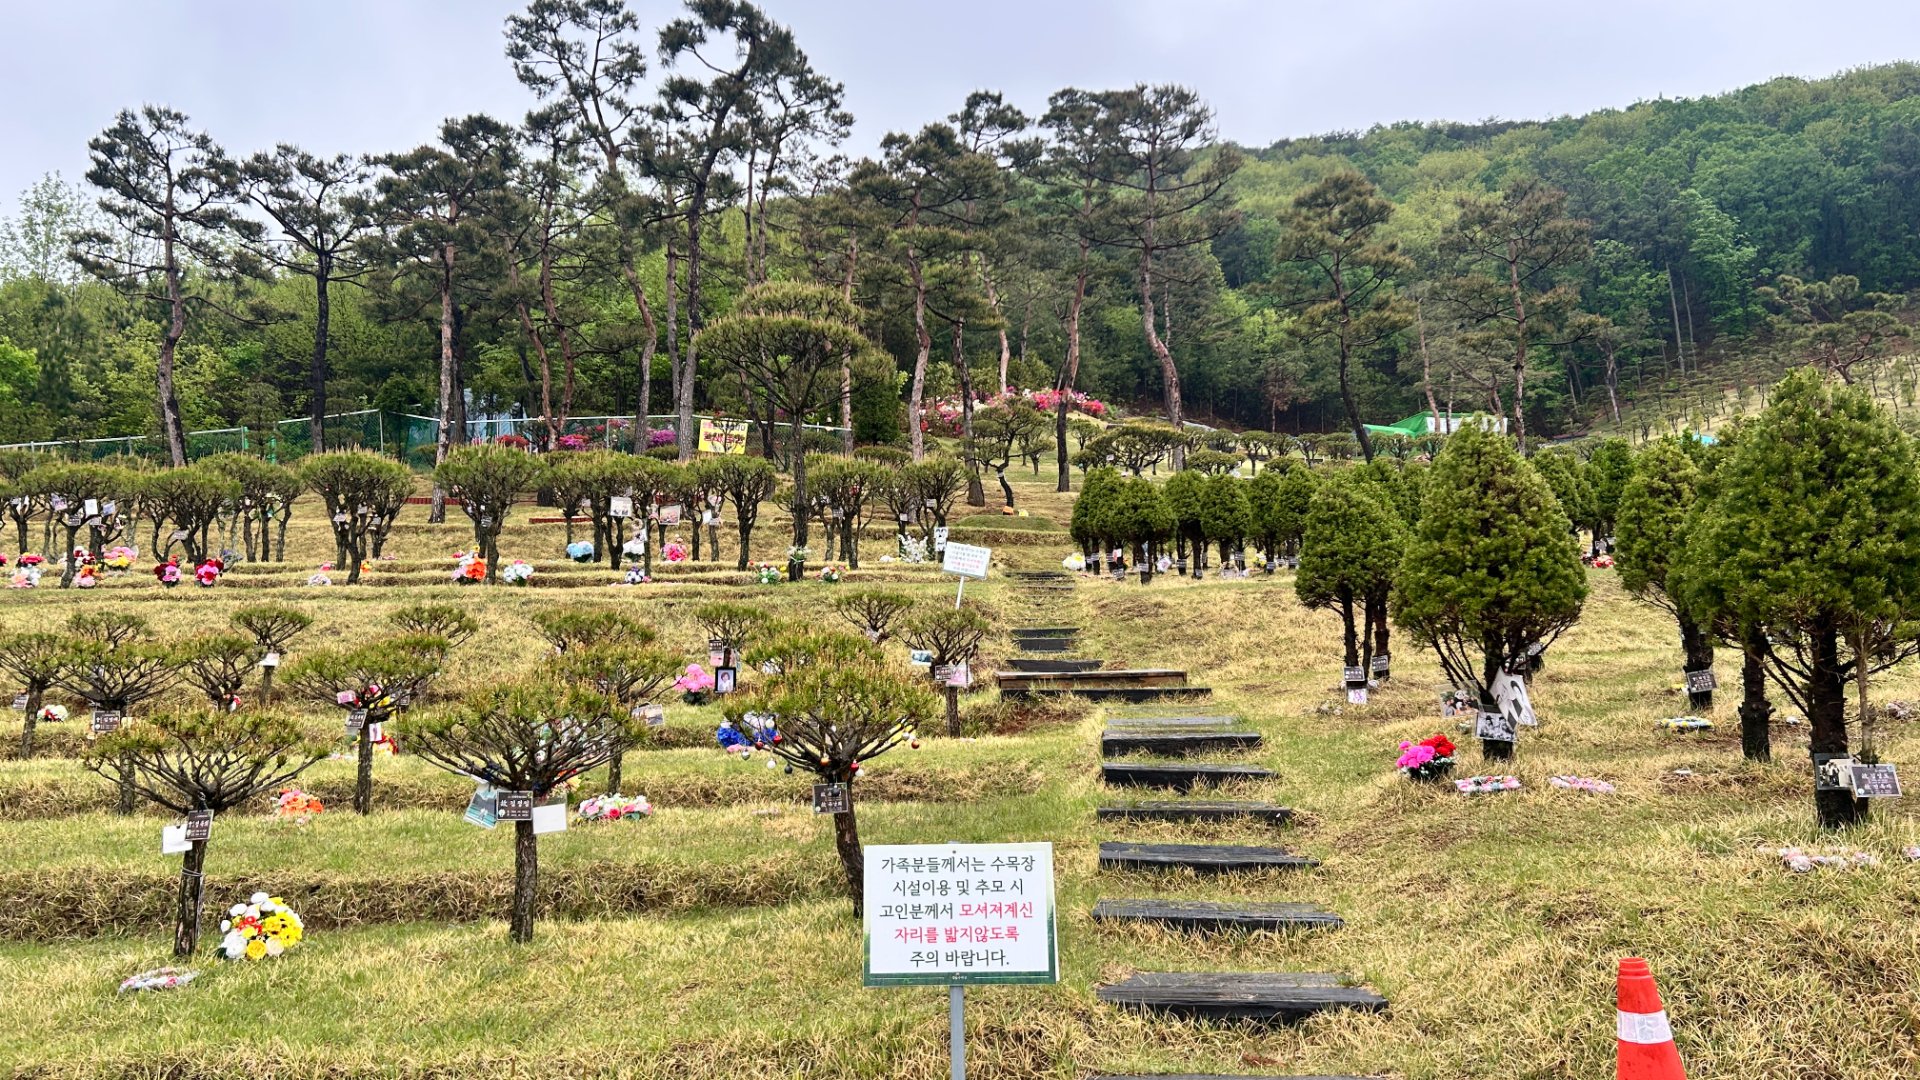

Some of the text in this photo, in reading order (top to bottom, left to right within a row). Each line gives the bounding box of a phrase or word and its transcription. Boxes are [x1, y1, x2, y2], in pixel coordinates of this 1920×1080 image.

[881, 855, 1036, 874] 가족분들께서는 수목장
[893, 878, 1023, 897] 시설이용 및 추모 시
[879, 901, 1033, 920] 고인분께서 모셔져계신
[894, 925, 1020, 944] 자리를 밟지않도록
[909, 949, 1010, 968] 주의 바랍니다.
